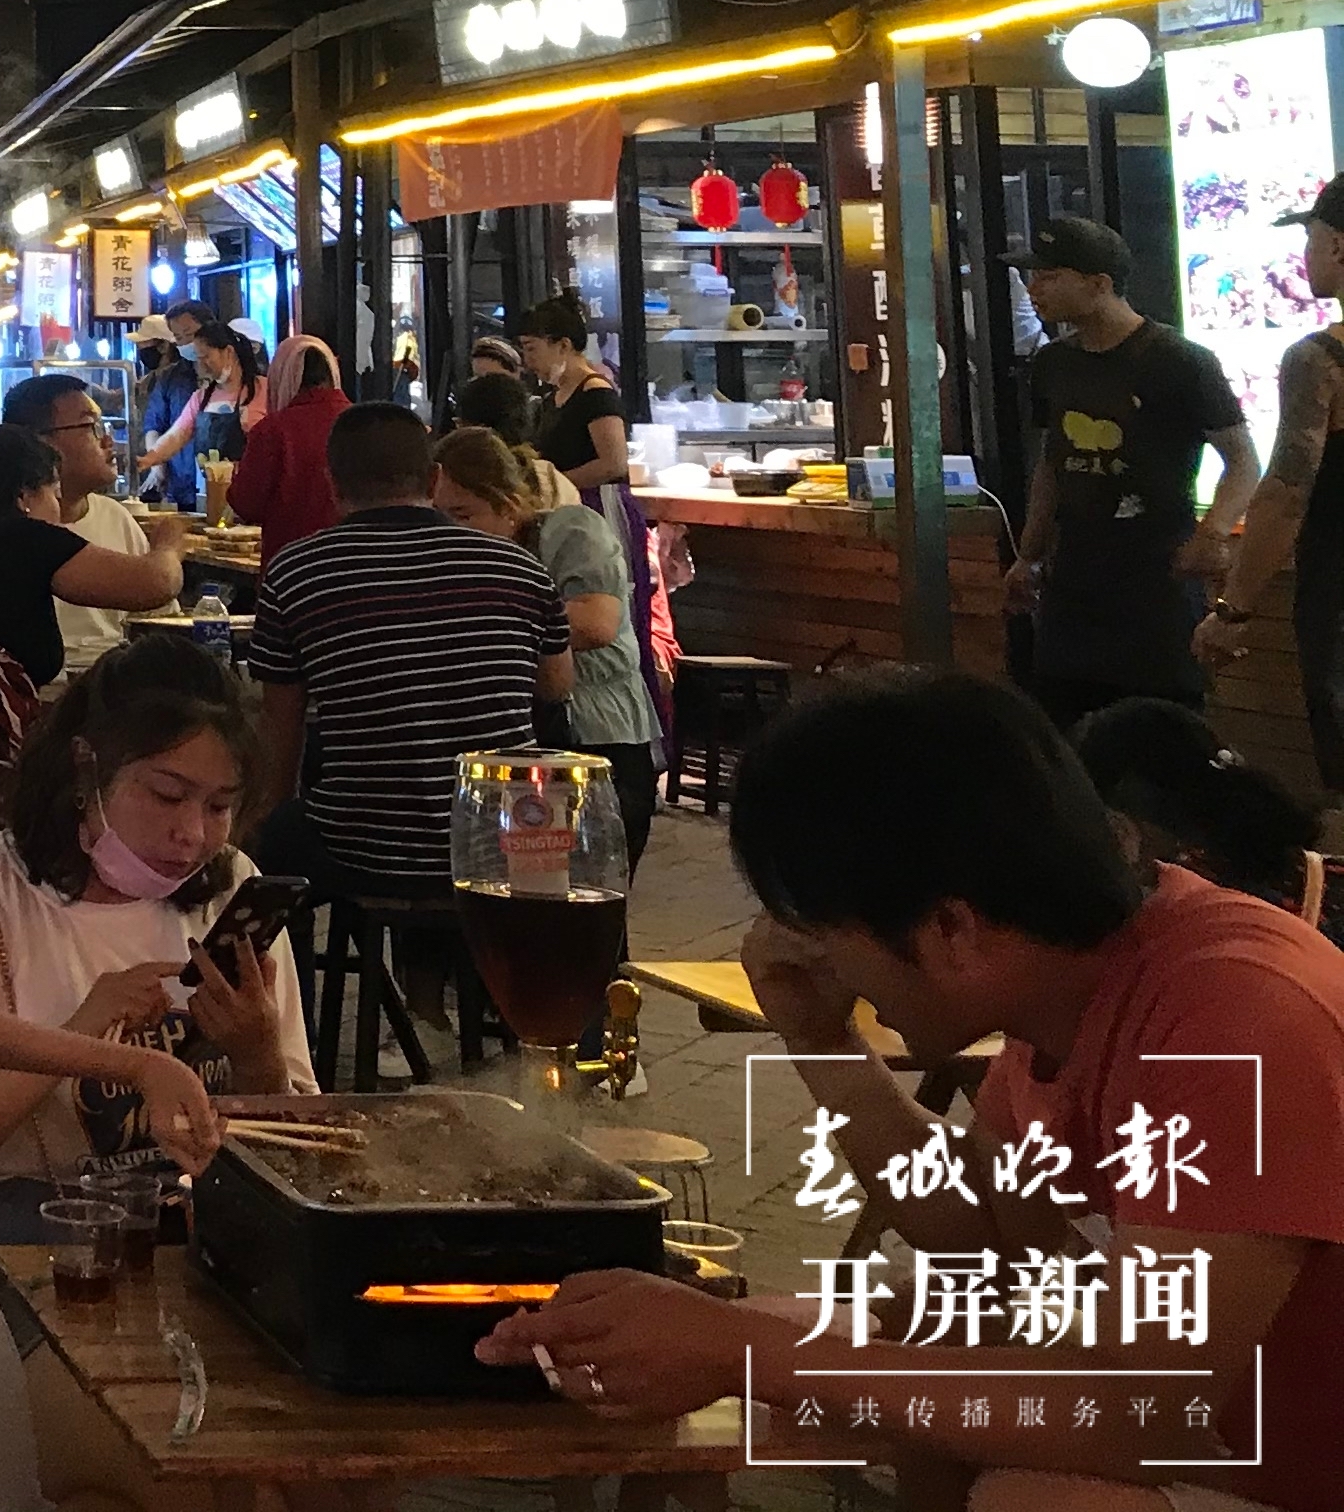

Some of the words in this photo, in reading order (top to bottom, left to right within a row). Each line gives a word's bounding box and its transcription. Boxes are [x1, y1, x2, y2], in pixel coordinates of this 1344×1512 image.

[38, 257, 56, 314] 青花粥
[111, 235, 133, 313] 青花粥舍
